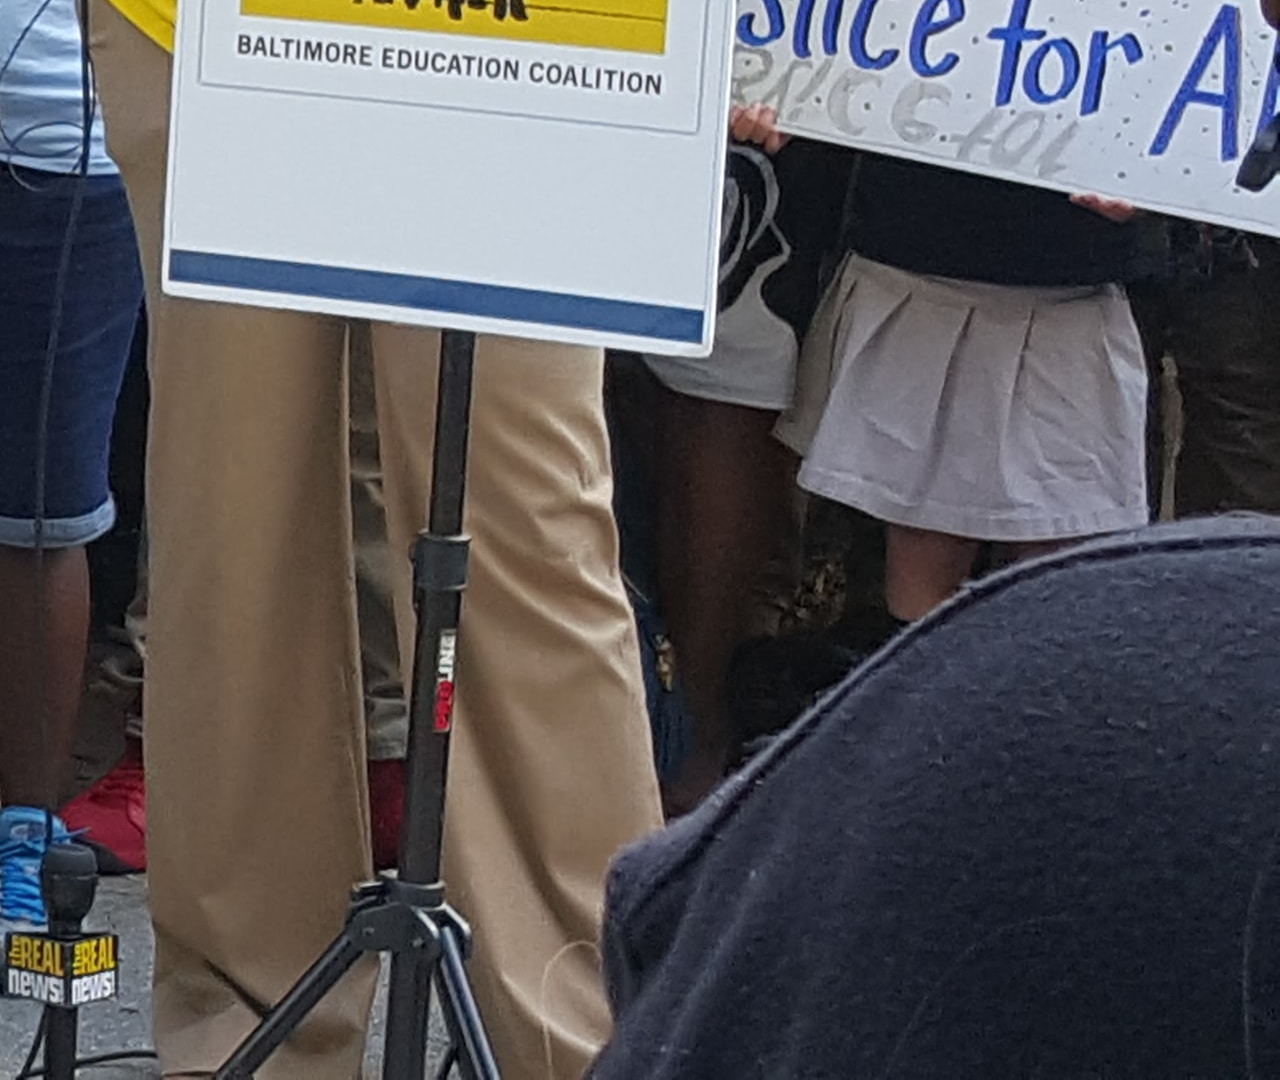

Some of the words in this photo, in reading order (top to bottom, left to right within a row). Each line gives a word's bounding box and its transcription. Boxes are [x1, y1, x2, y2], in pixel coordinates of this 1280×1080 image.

[236, 33, 374, 68] BALTIMORE
[380, 47, 521, 82] EDUCATION
[528, 61, 663, 96] COALITION
[20, 935, 65, 978] REAL
[81, 935, 116, 973] REAL
